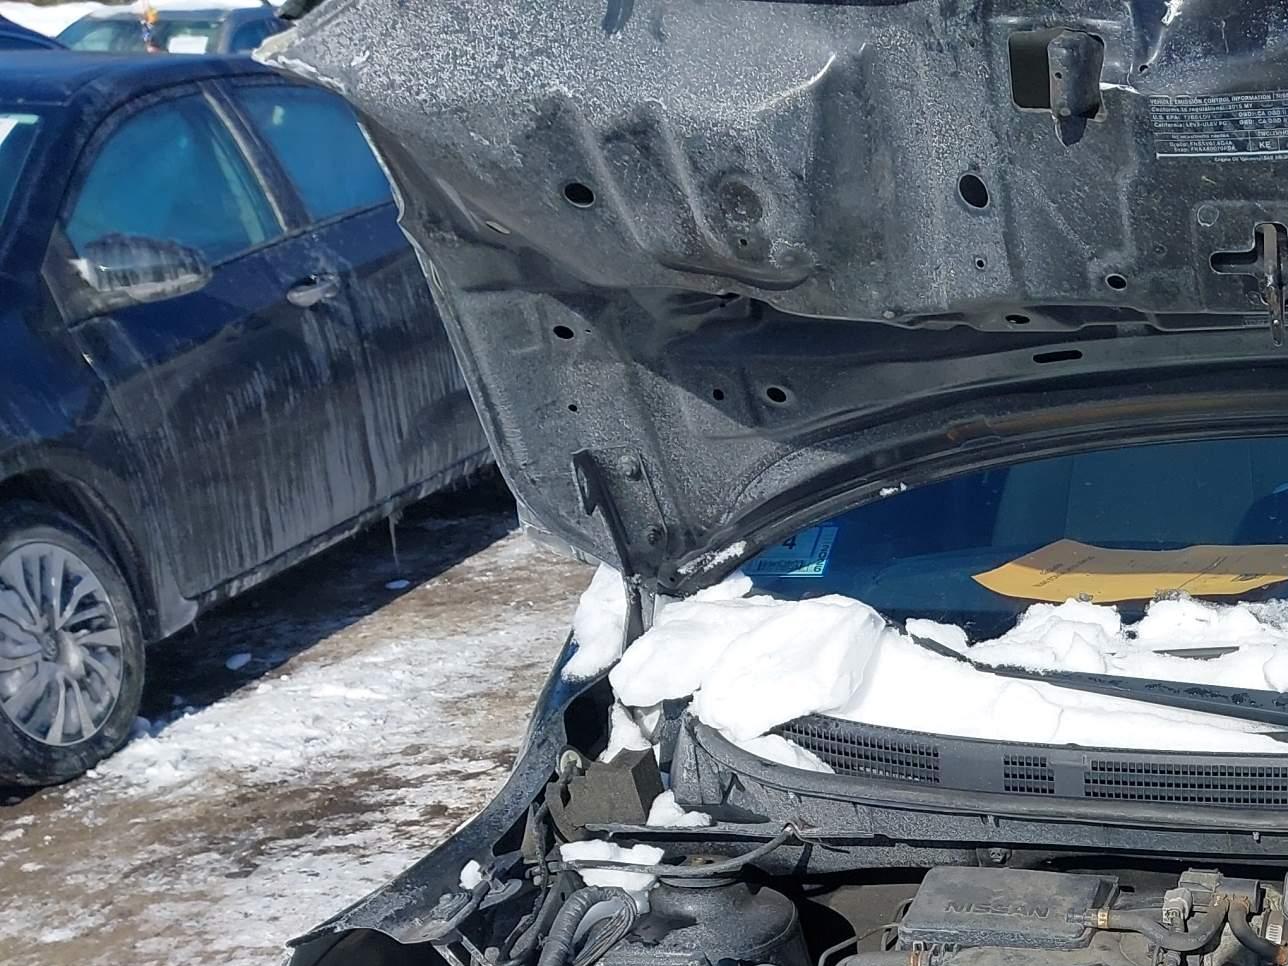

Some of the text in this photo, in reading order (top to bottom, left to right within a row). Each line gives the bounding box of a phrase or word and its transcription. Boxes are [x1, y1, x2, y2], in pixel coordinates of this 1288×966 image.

[1259, 141, 1271, 149] KE
[782, 535, 797, 550] 4
[944, 901, 1050, 919] NISSAN
